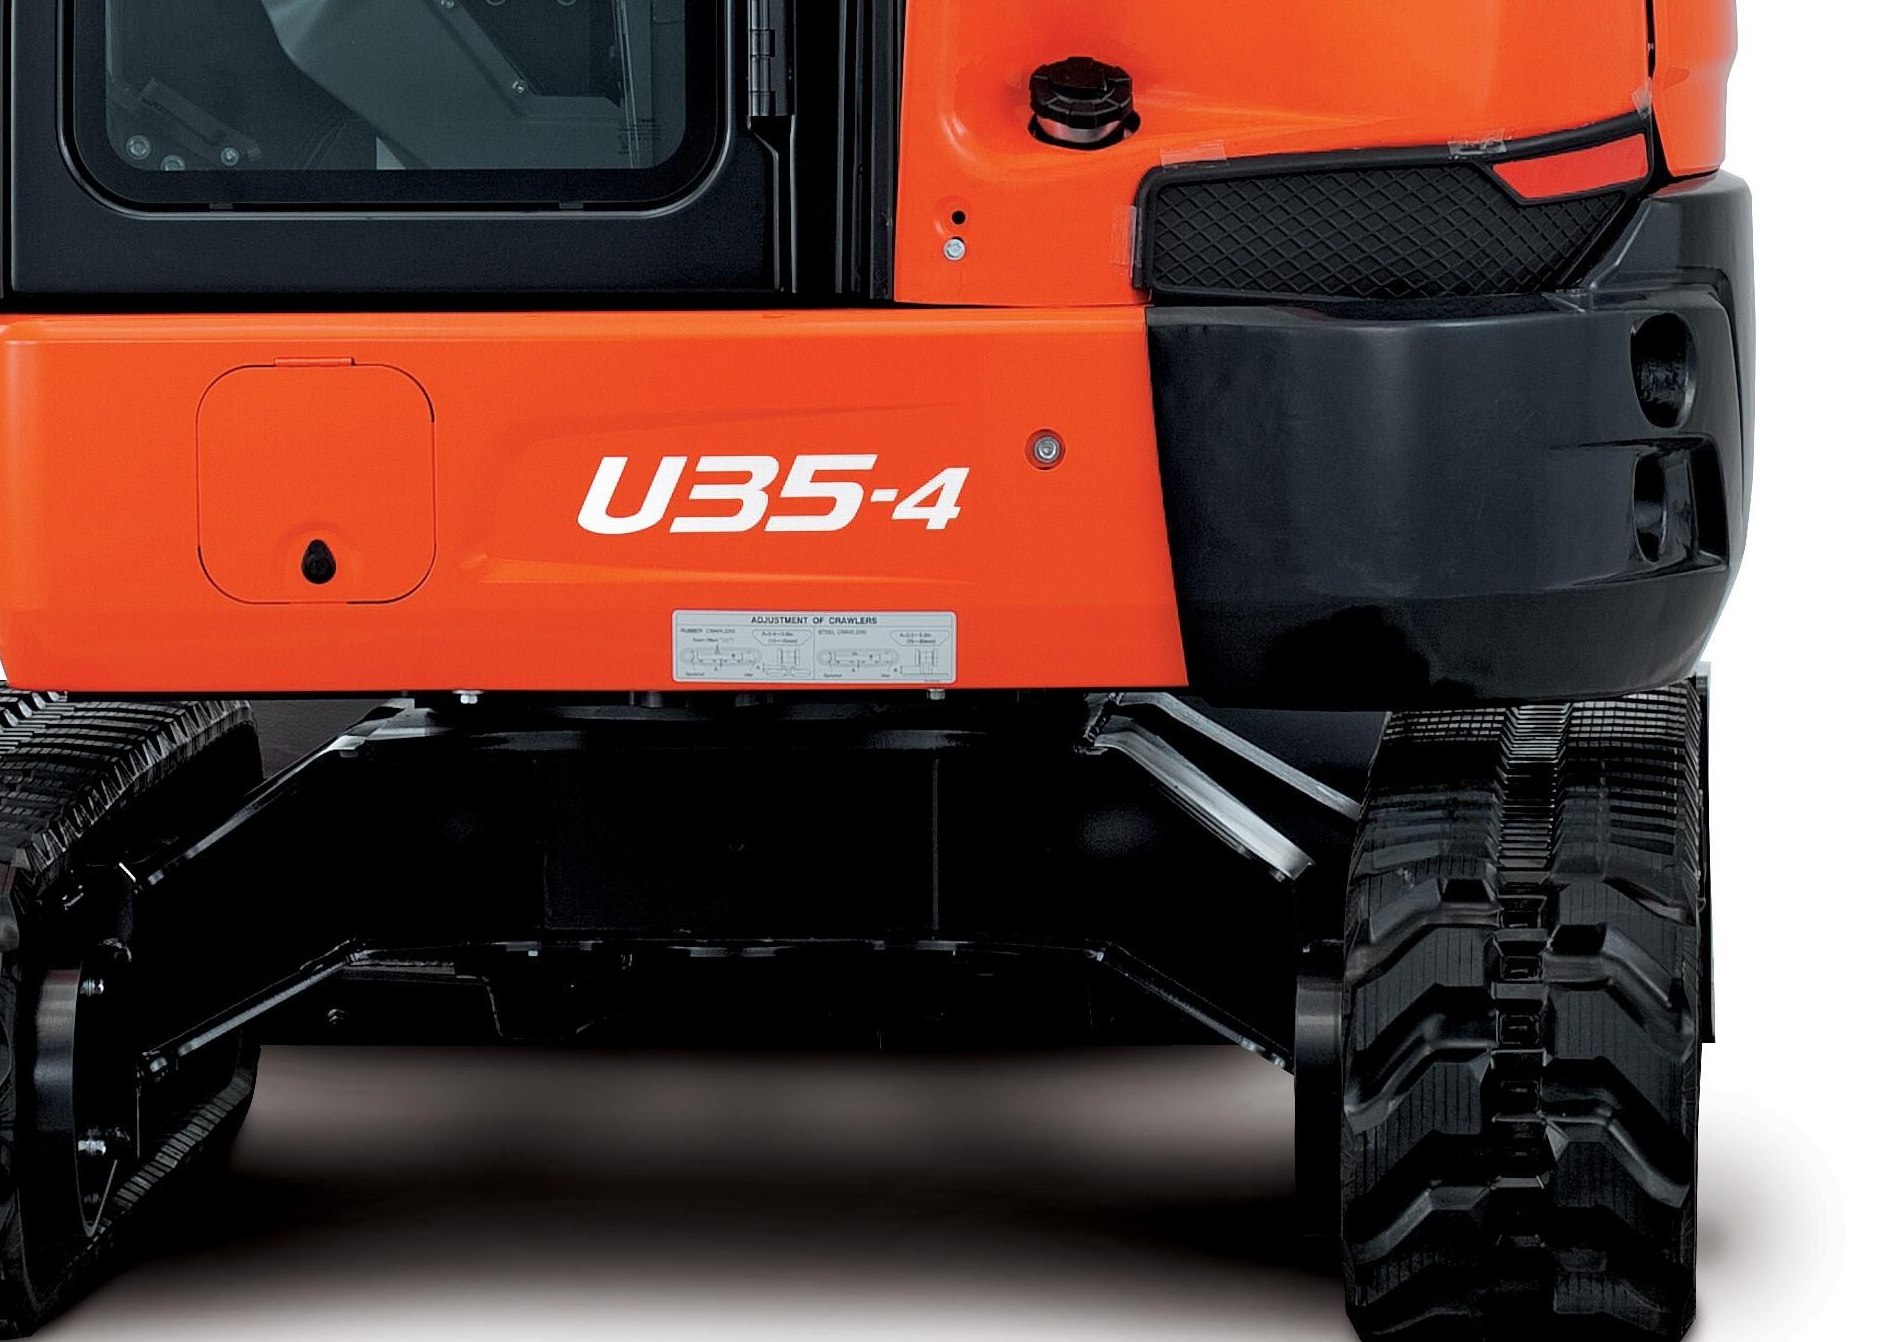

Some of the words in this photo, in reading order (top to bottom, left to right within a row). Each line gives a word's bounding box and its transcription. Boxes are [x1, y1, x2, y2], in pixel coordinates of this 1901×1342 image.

[577, 453, 970, 535] U35-4
[751, 616, 809, 625] ADJUSTMENT
[811, 616, 824, 625] OF
[828, 617, 878, 625] CRAWLERS
